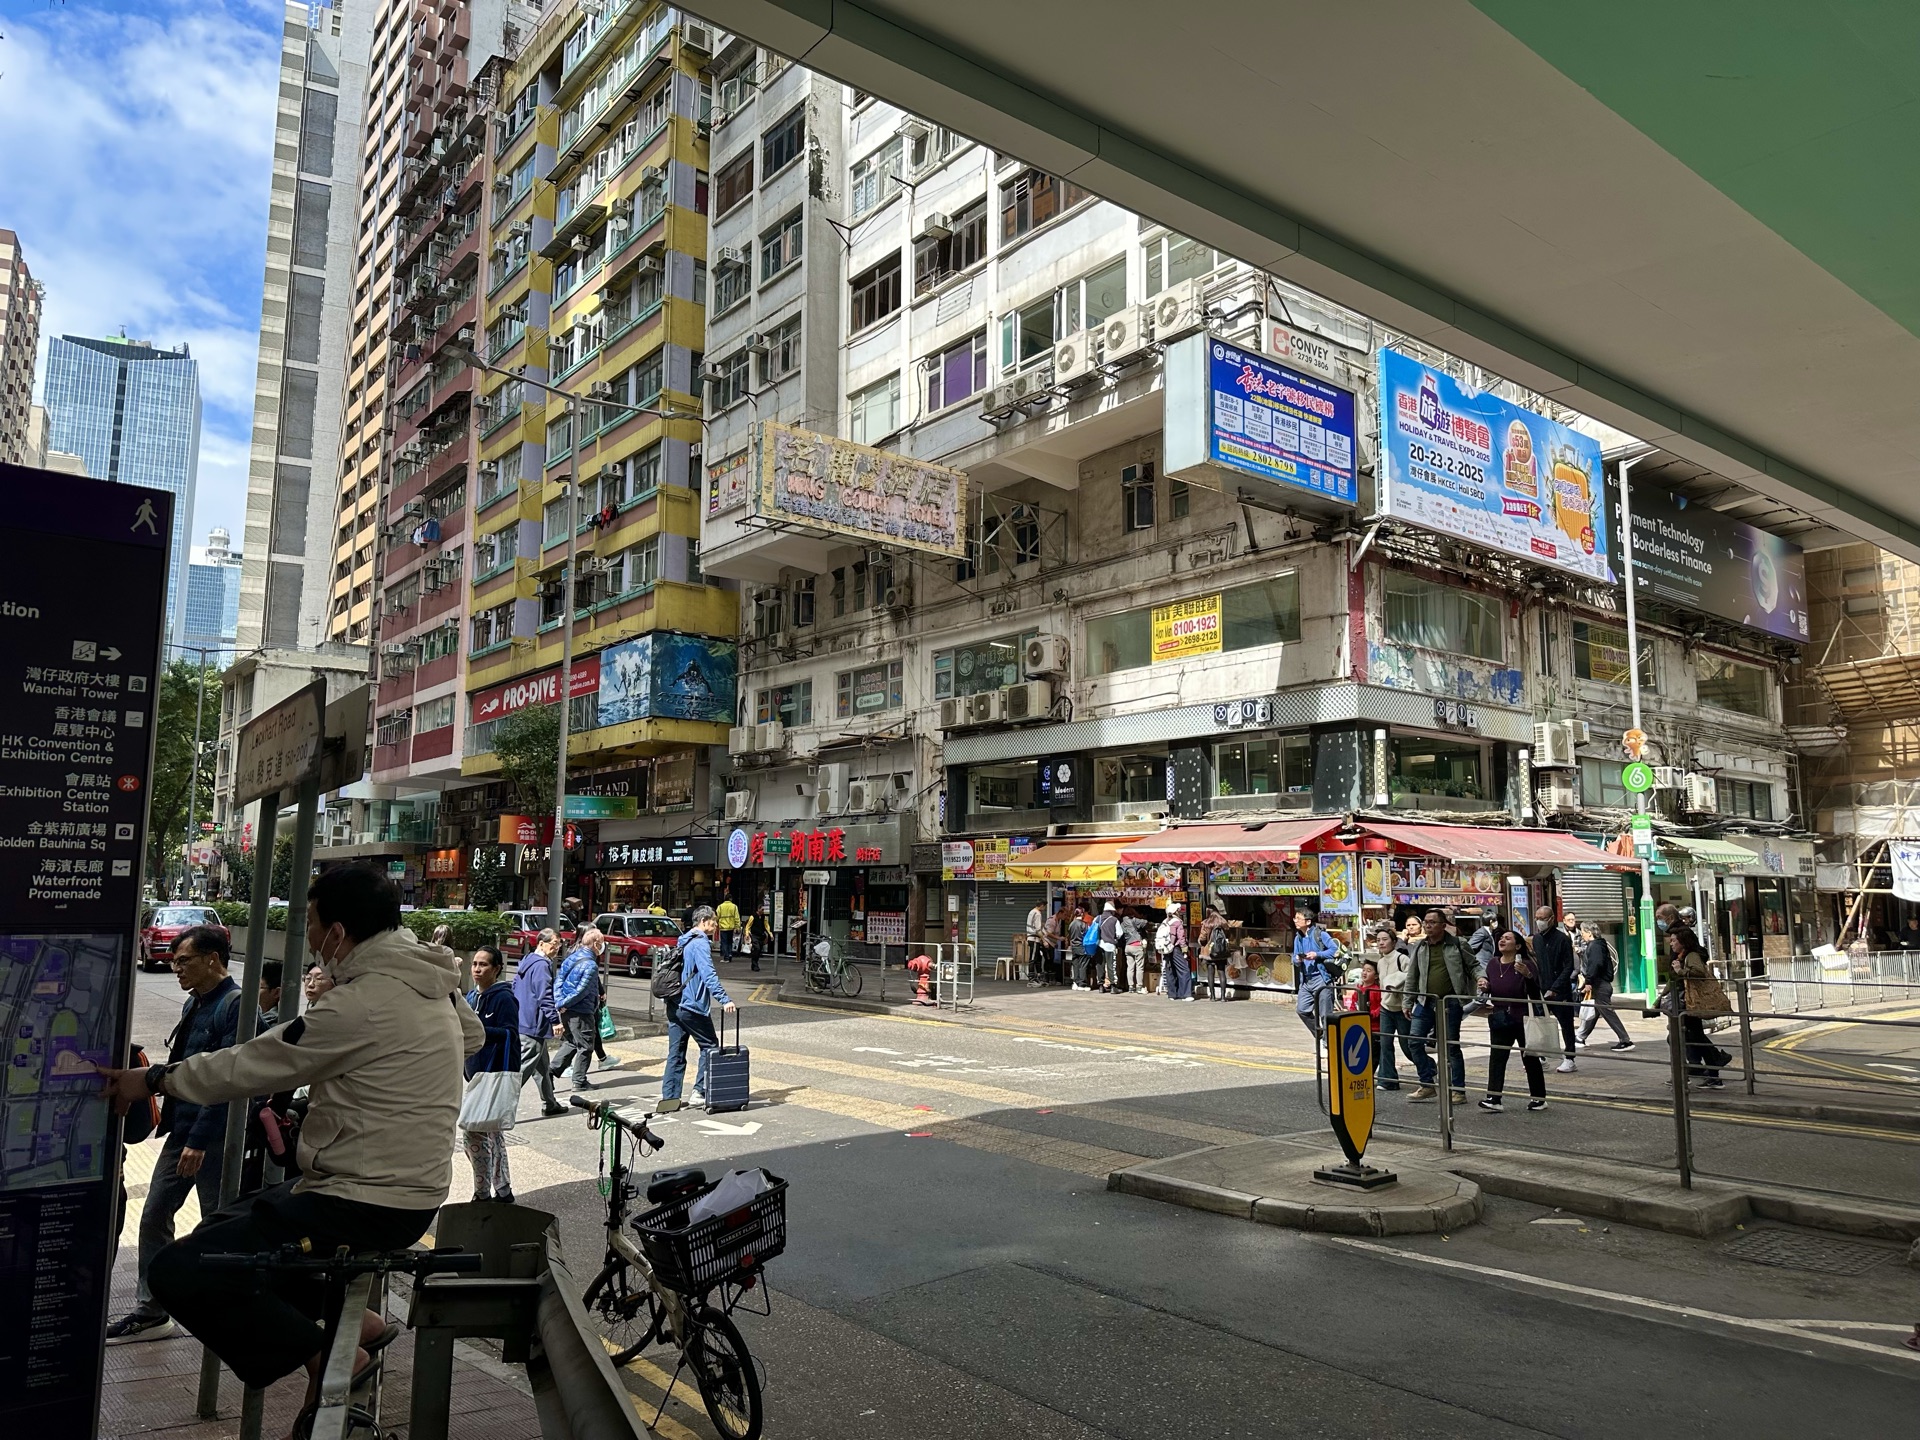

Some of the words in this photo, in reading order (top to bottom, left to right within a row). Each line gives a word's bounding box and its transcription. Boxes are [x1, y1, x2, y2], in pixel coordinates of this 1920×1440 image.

[1291, 336, 1328, 360] CONVEY
[1298, 352, 1312, 363] 2739
[1314, 359, 1328, 370] 3806
[1274, 415, 1298, 431] 香港移民
[1398, 391, 1490, 450] 香港旅遊博覽會
[1399, 410, 1408, 419] HONG
[1409, 412, 1418, 422] KONG
[1400, 421, 1428, 438] HOLIDAY
[1434, 434, 1458, 450] TRAVEL
[1458, 444, 1476, 457] EXPO
[1476, 450, 1490, 462] 2025
[1252, 451, 1272, 466] 2802
[1274, 458, 1294, 472] 8798
[1410, 465, 1436, 484] 灣仔會展
[1438, 476, 1456, 490] HKCEC
[1458, 484, 1470, 496] Hall
[842, 487, 889, 514] COURT
[906, 504, 948, 530] HOTEL
[1615, 502, 1656, 532] Pyment
[1657, 518, 1704, 555] Technology
[1633, 532, 1679, 563] Borderless
[1680, 549, 1712, 575] Finance
[0, 600, 40, 618] tion
[1172, 597, 1217, 618] 美聯旺舖
[1174, 615, 1217, 636] 8100-1923
[1184, 631, 1218, 645] 2698-2128
[26, 666, 120, 687] 灣仔政府大樓
[986, 666, 1002, 678] Gifts
[23, 682, 76, 696] Wanchai
[81, 687, 119, 700] Tower
[503, 675, 556, 711] PRO-DIVE
[55, 706, 117, 724] 香港會議
[675, 708, 712, 716] BARE
[53, 722, 116, 739] 展覽中心
[252, 718, 278, 750] Lockhart
[278, 707, 297, 735] Road
[2, 735, 24, 746] HK
[28, 736, 100, 752] Convention
[105, 742, 114, 752] &
[2, 748, 65, 762] Exhibition
[70, 752, 114, 764] Centre
[65, 772, 112, 788] 會展站
[0, 786, 62, 798] Exhibition
[67, 789, 110, 800] Centre
[1055, 786, 1074, 794] Modern
[63, 802, 109, 813] Station
[28, 821, 107, 837] 金紫荊廣場
[40, 838, 86, 849] Bauhinia
[90, 839, 106, 852] Sq
[40, 859, 104, 873] 海濱長廊
[1024, 866, 1092, 880] 街坊美食
[32, 875, 102, 886] Waterfront
[28, 888, 101, 899] Promenade
[1349, 1080, 1367, 1091] 47897
